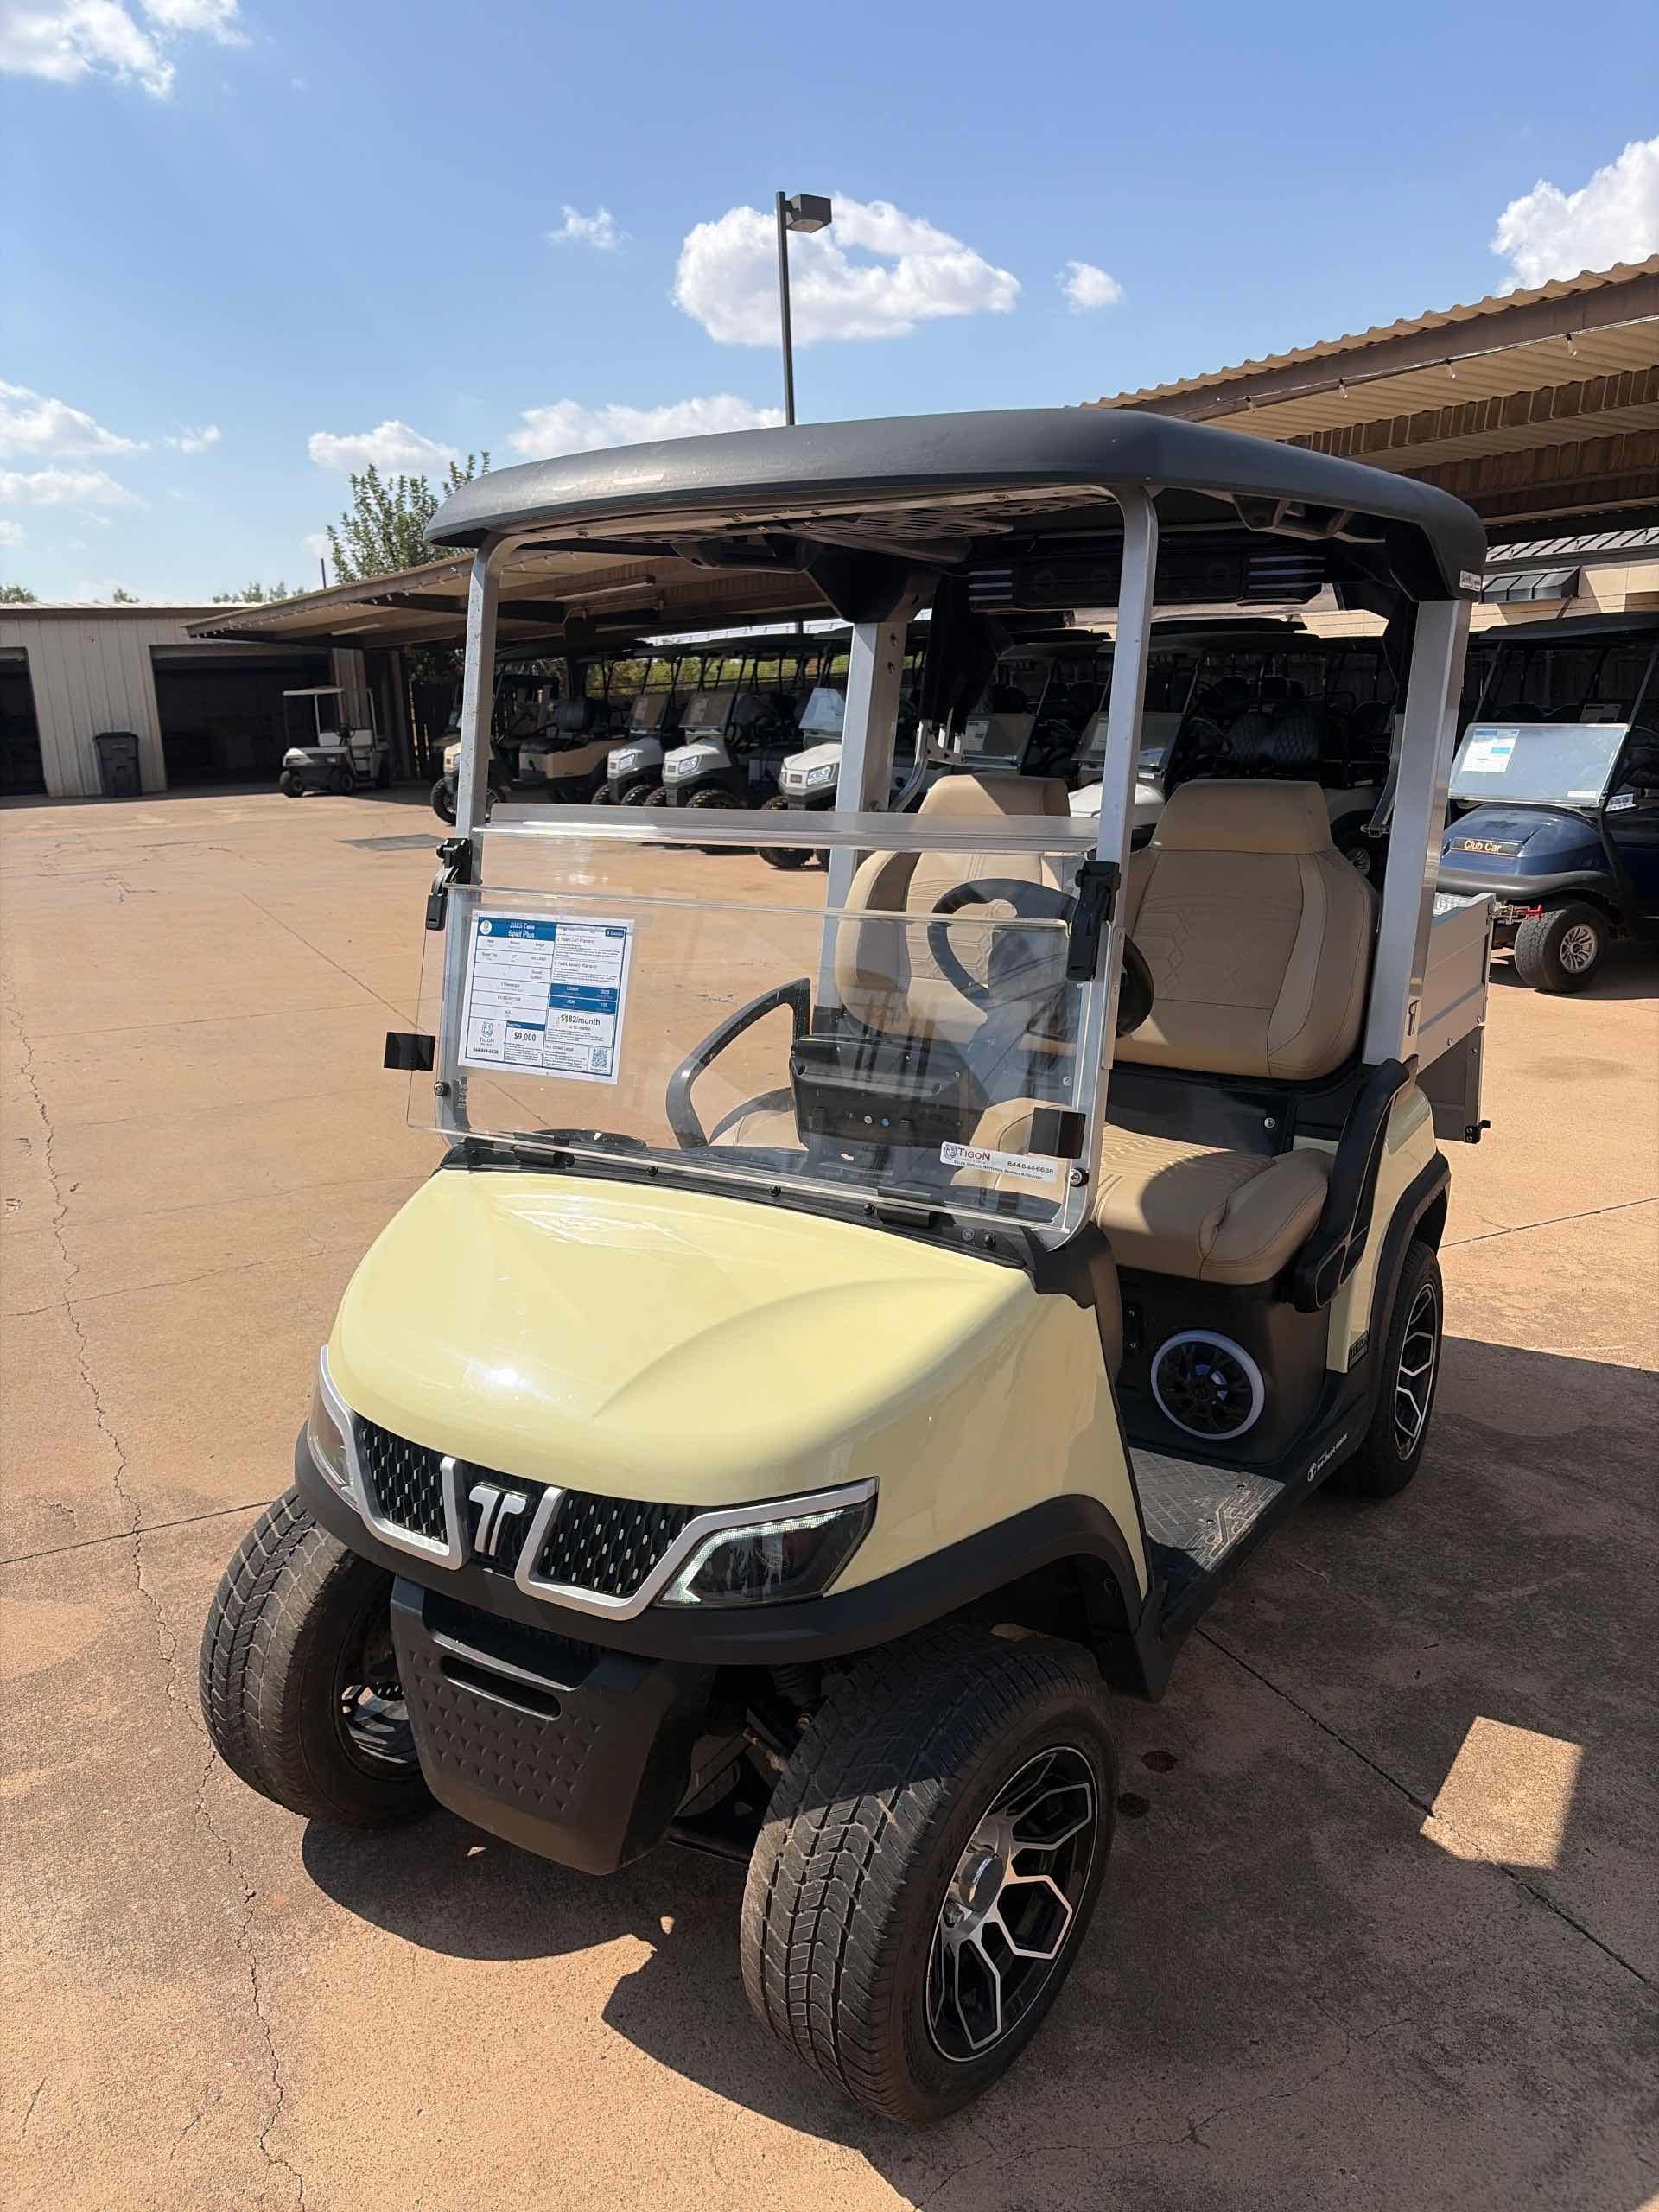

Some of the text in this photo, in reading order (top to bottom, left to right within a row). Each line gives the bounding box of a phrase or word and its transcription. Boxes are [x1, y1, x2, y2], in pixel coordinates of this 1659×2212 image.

[1465, 840, 1502, 852] Club Car
[561, 1014, 601, 1026] $182/month
[514, 1032, 537, 1042] $9,000
[957, 1147, 991, 1161] TIGON
